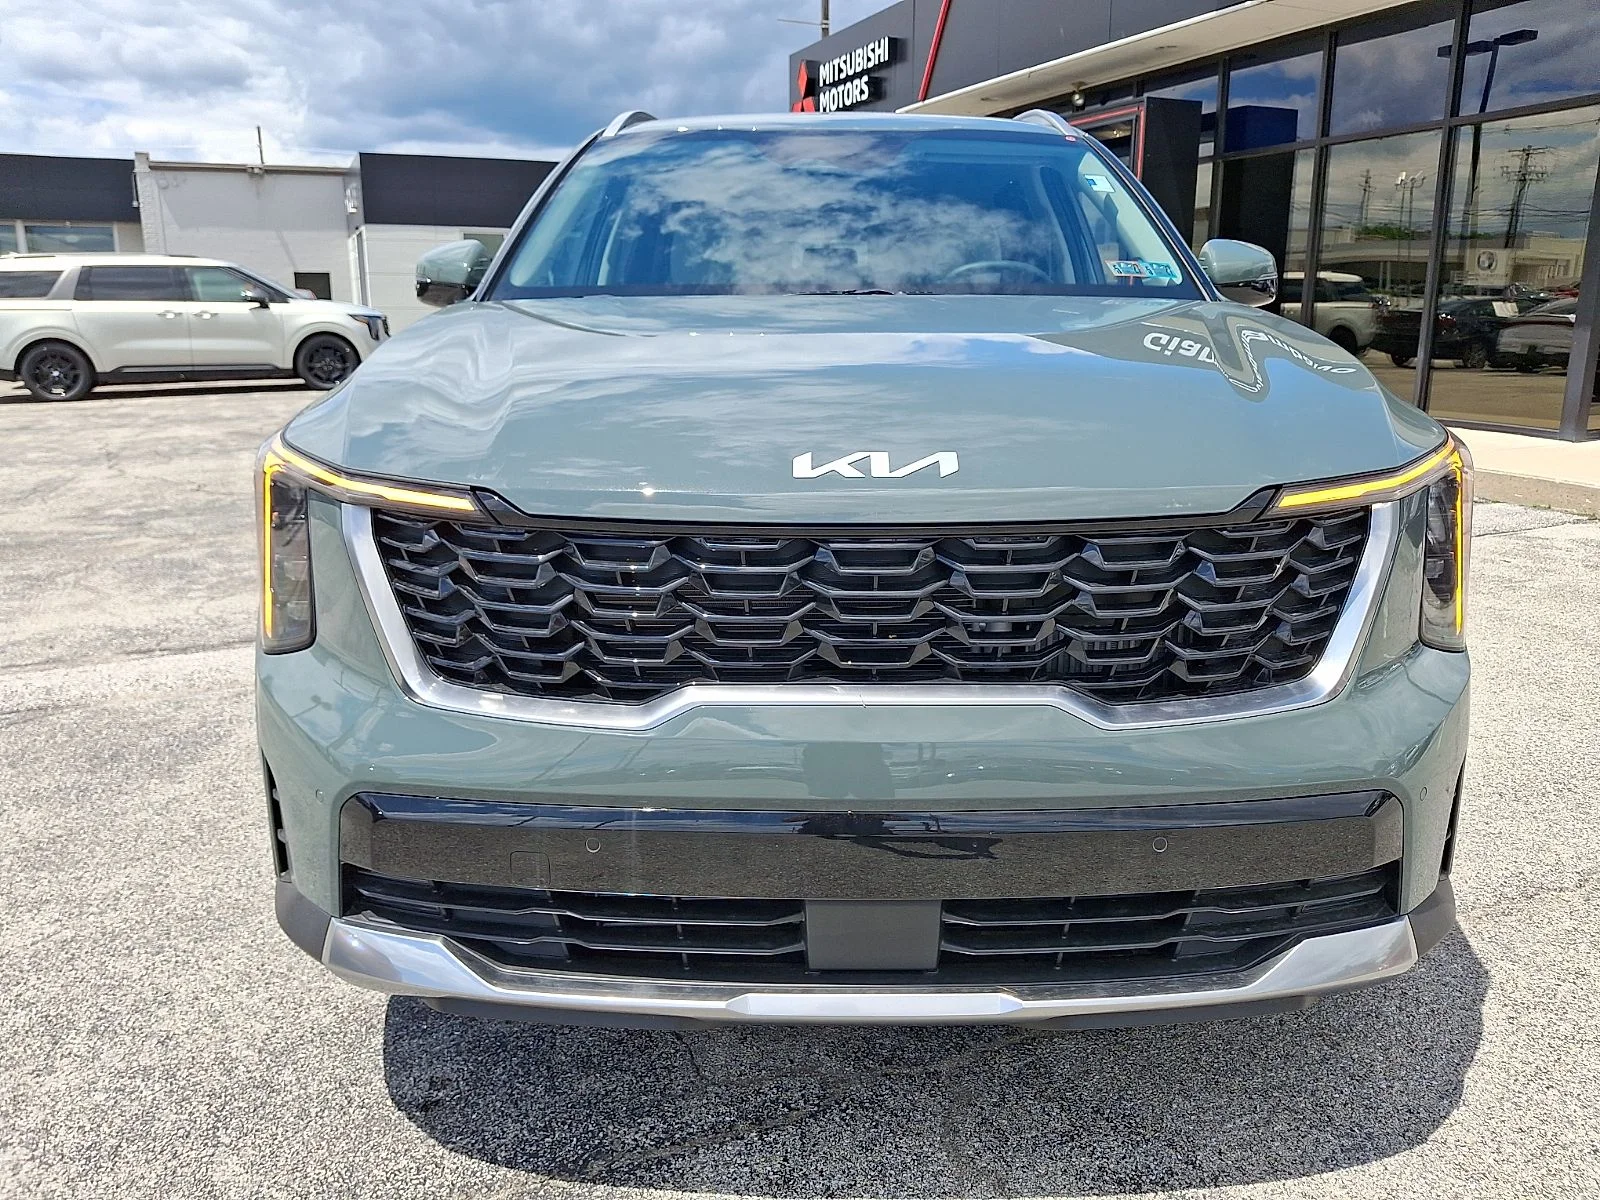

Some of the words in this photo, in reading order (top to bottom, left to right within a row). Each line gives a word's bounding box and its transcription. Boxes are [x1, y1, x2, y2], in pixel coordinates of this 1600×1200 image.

[819, 36, 889, 87] MITSUBISHI
[819, 75, 869, 112] MOTORS
[792, 451, 960, 479] KIA
